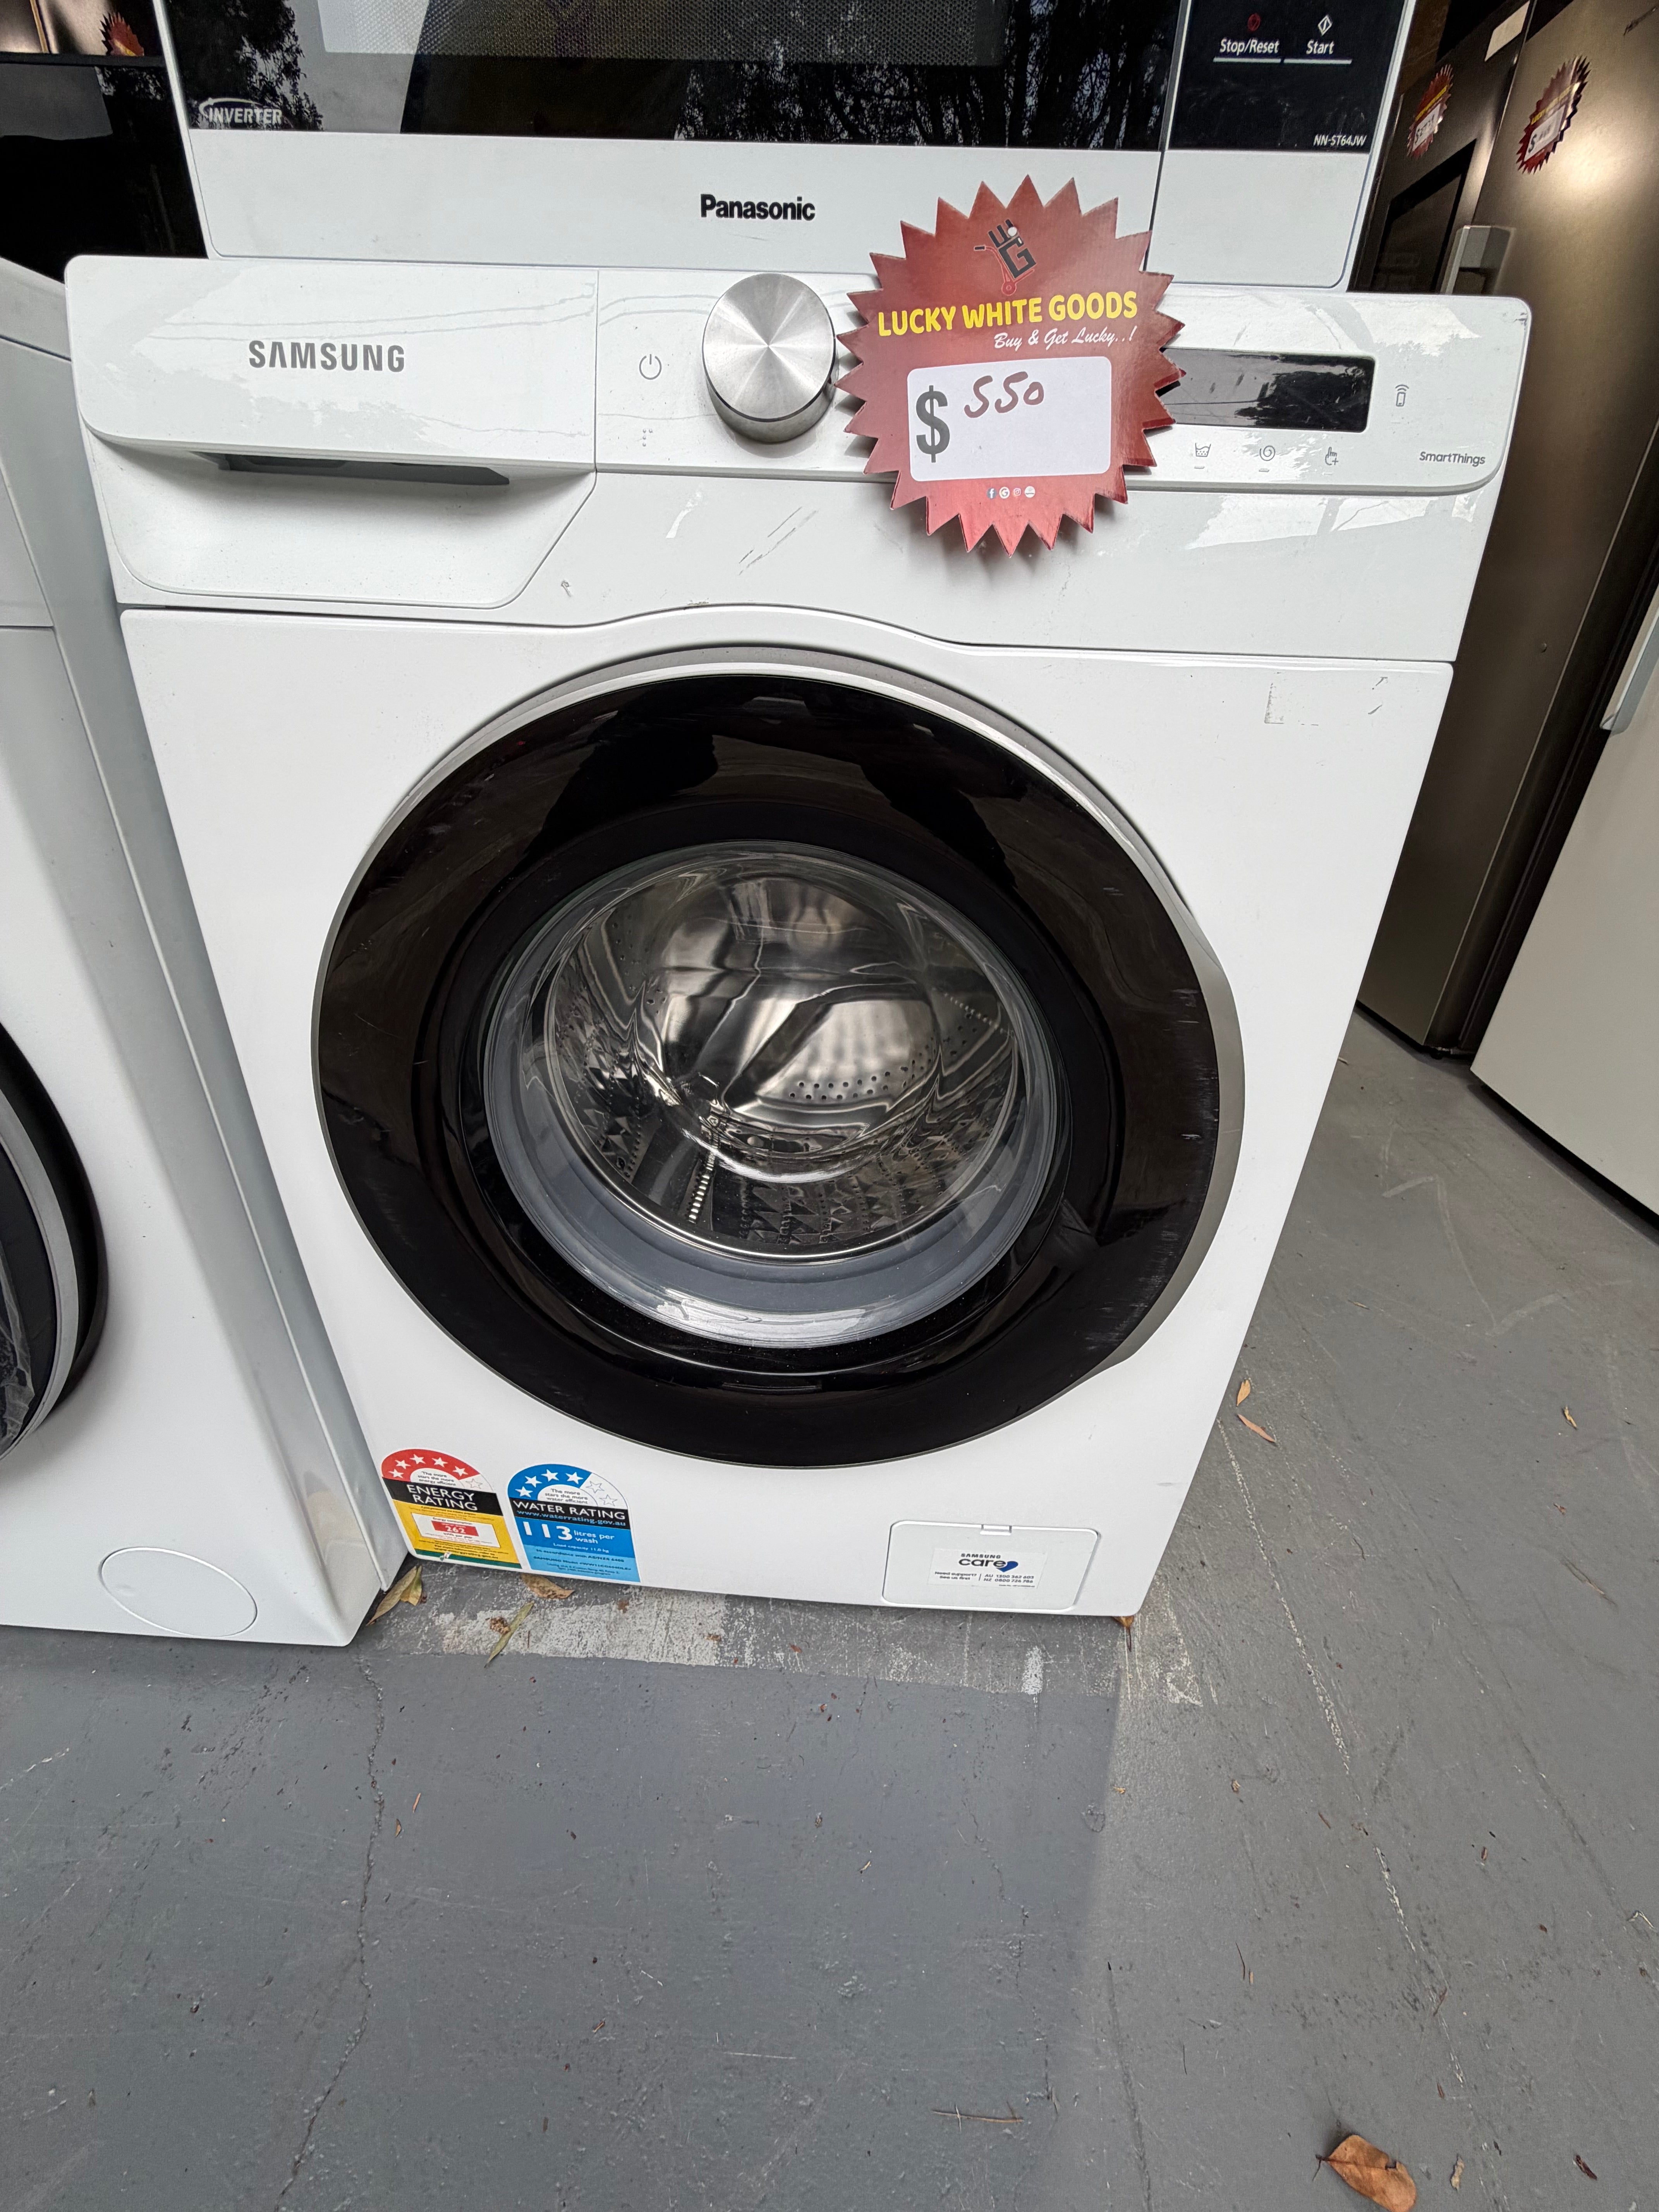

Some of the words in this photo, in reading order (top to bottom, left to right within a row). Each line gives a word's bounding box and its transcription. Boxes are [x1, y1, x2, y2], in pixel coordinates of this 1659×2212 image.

[1219, 38, 1279, 56] Stop/Reset
[1306, 39, 1334, 55] Start
[209, 108, 283, 124] INVERTER
[1313, 134, 1367, 147] NN-ST64JW
[701, 194, 815, 221] Panasonic
[878, 306, 956, 336] LUCKY
[962, 297, 1042, 328] WHITE
[1049, 291, 1137, 321] GOODS
[994, 332, 1022, 351] Buy
[1028, 329, 1039, 345] &
[1044, 328, 1068, 350] Get
[249, 340, 405, 373] SAMSUNG
[916, 385, 950, 462] $
[964, 372, 1044, 418] 550
[1419, 452, 1486, 467] SmartThings
[406, 1484, 474, 1501] ENERGY
[412, 1494, 478, 1511] RATING
[513, 1501, 565, 1514] WATER
[569, 1507, 625, 1520] RATING
[517, 1510, 626, 1526] www.waterrating.gov.au
[445, 1526, 466, 1534] 262
[523, 1521, 572, 1540] 113
[958, 1559, 1006, 1568] care
